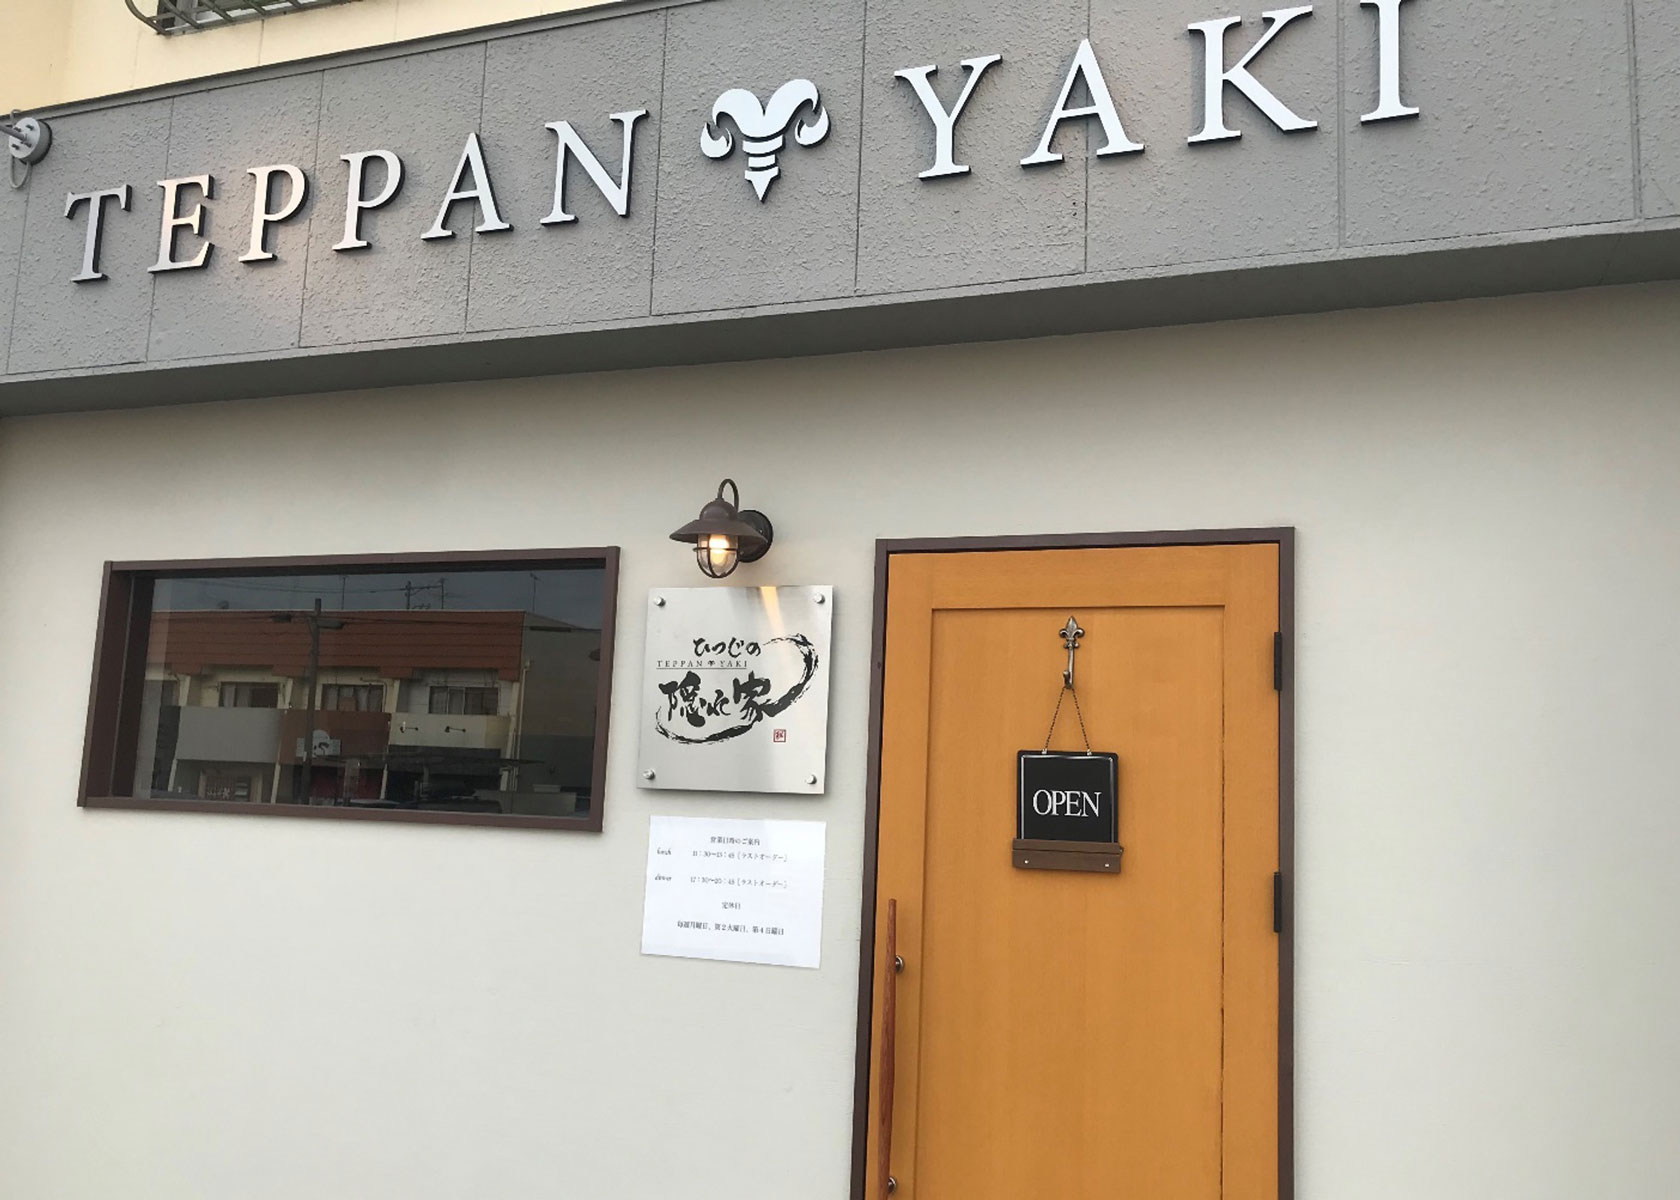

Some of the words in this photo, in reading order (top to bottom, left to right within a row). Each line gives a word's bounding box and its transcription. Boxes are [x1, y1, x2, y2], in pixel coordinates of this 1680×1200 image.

[64, 108, 648, 284] TEPPAN
[894, 0, 1421, 179] YAKI
[693, 637, 762, 659] ひつじの
[657, 659, 703, 668] TEPPAN
[719, 659, 748, 668] YAKI
[658, 670, 772, 728] 隠れ家
[1033, 789, 1102, 817] OPEN
[721, 901, 741, 910] 定休日
